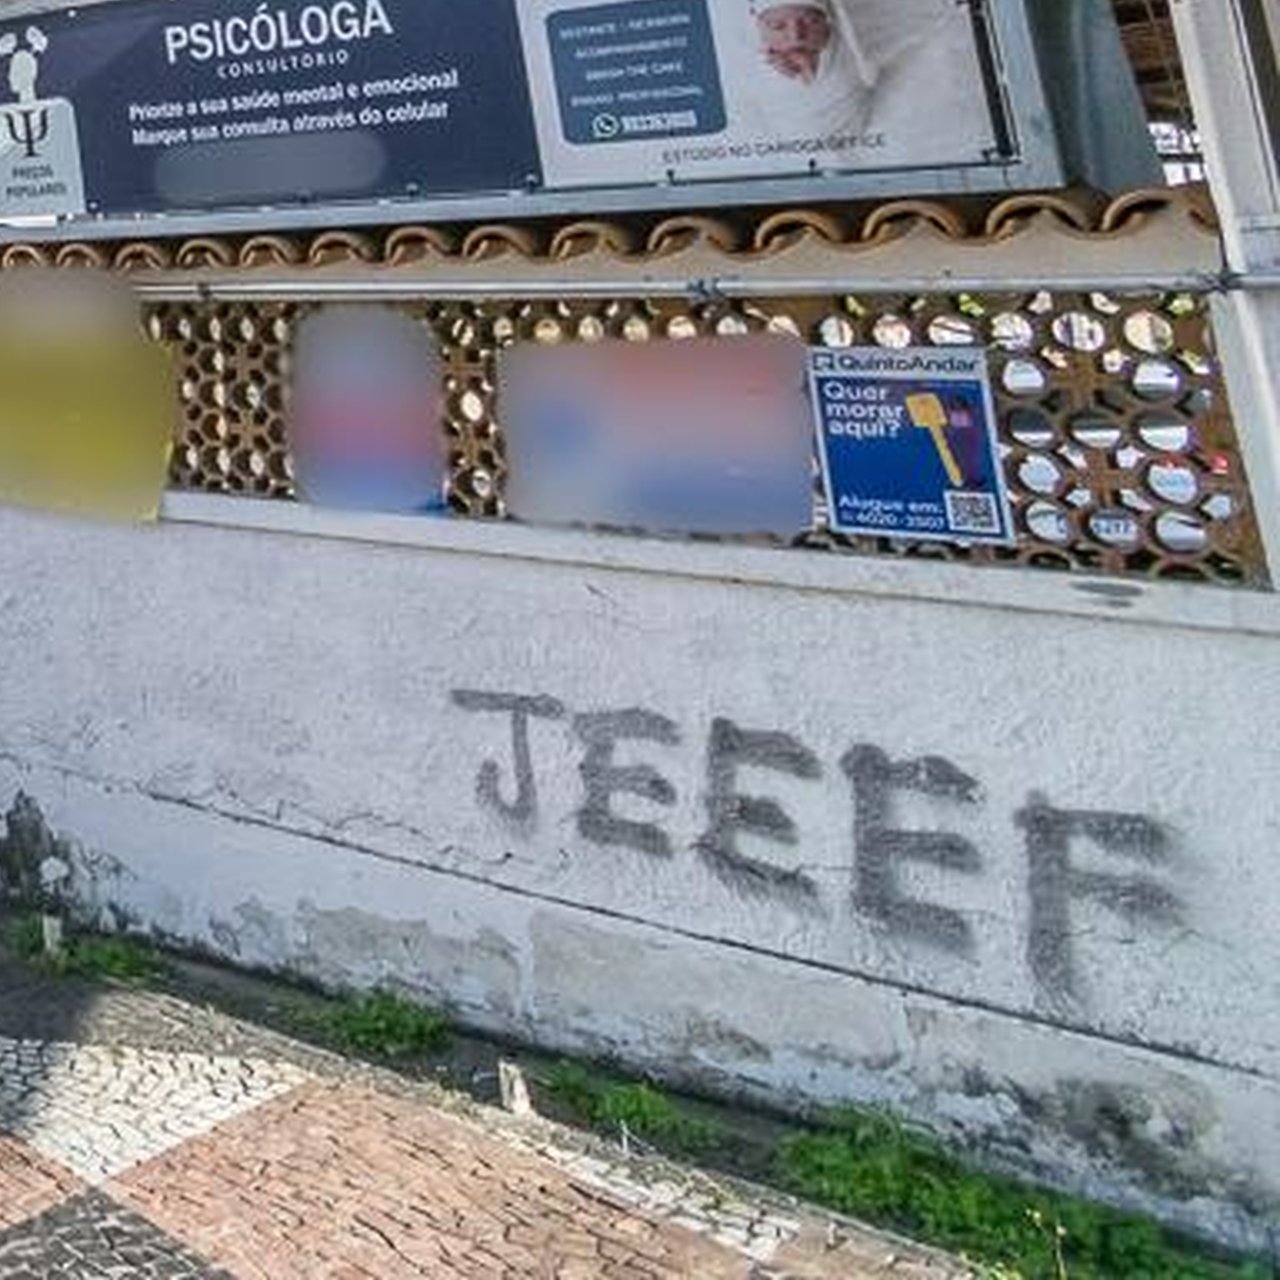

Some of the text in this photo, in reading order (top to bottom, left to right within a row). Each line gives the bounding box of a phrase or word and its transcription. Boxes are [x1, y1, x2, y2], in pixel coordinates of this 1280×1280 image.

[187, 102, 197, 115] a
[282, 81, 344, 105] mental
[347, 83, 359, 98] e
[362, 68, 459, 98] emocional
[132, 127, 187, 146] Marque
[191, 125, 219, 141] sua
[222, 116, 290, 138] consulta
[386, 100, 449, 124] celular
[839, 354, 979, 372] QuintoAndar
[823, 380, 888, 402] Quer
[826, 402, 905, 419] morar
[828, 419, 902, 440] aqui?
